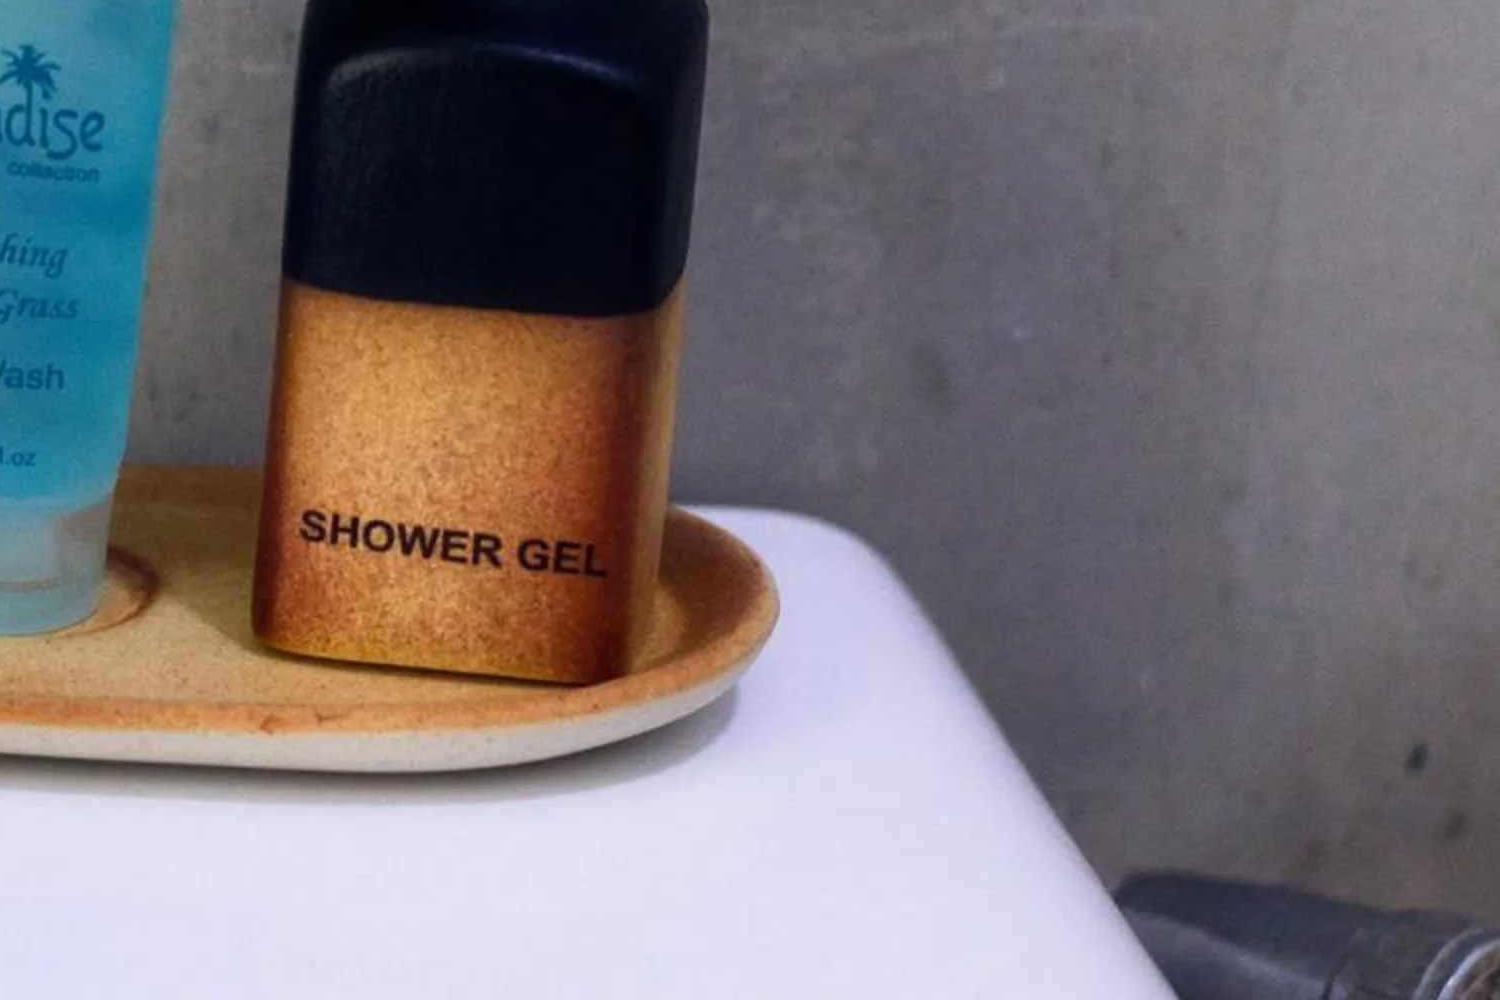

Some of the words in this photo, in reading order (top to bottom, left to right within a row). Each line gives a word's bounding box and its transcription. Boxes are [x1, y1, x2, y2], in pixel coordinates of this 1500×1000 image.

[6, 160, 99, 184] collection
[299, 509, 503, 569] SHOWER
[516, 537, 607, 578] GEL
